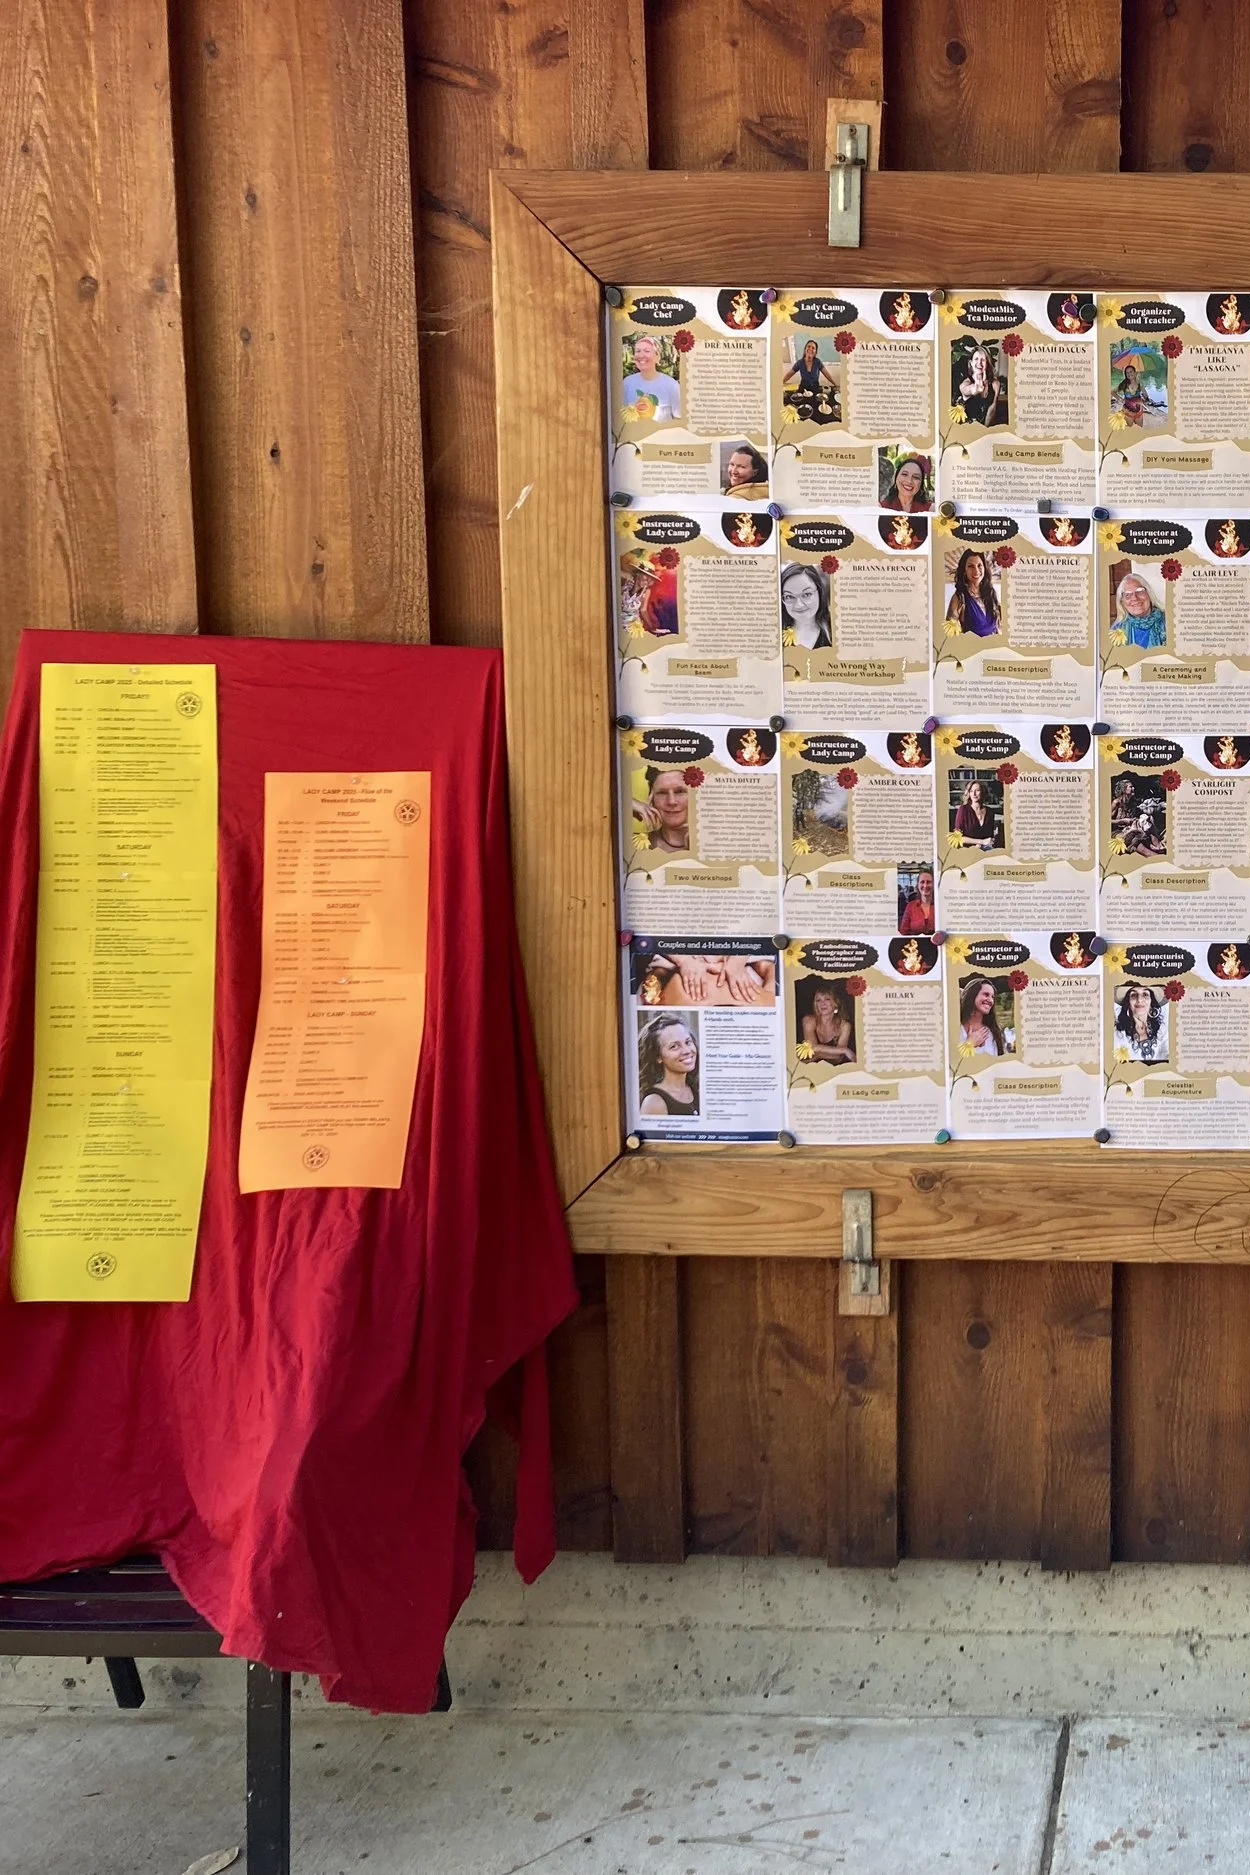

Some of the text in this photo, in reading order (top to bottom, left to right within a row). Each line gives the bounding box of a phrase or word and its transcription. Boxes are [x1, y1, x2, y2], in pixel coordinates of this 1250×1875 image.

[640, 301, 684, 311] Lady Camp
[969, 305, 1014, 314] ModestMix
[654, 311, 672, 319] Chef
[1131, 307, 1171, 317] Organizer
[967, 314, 1017, 323] Tea Donator
[1126, 316, 1176, 325] and Teacher
[827, 662, 885, 671] No Wrong Way
[862, 671, 896, 680] Workshop
[658, 941, 761, 951] Couples and 4-Hands Massage
